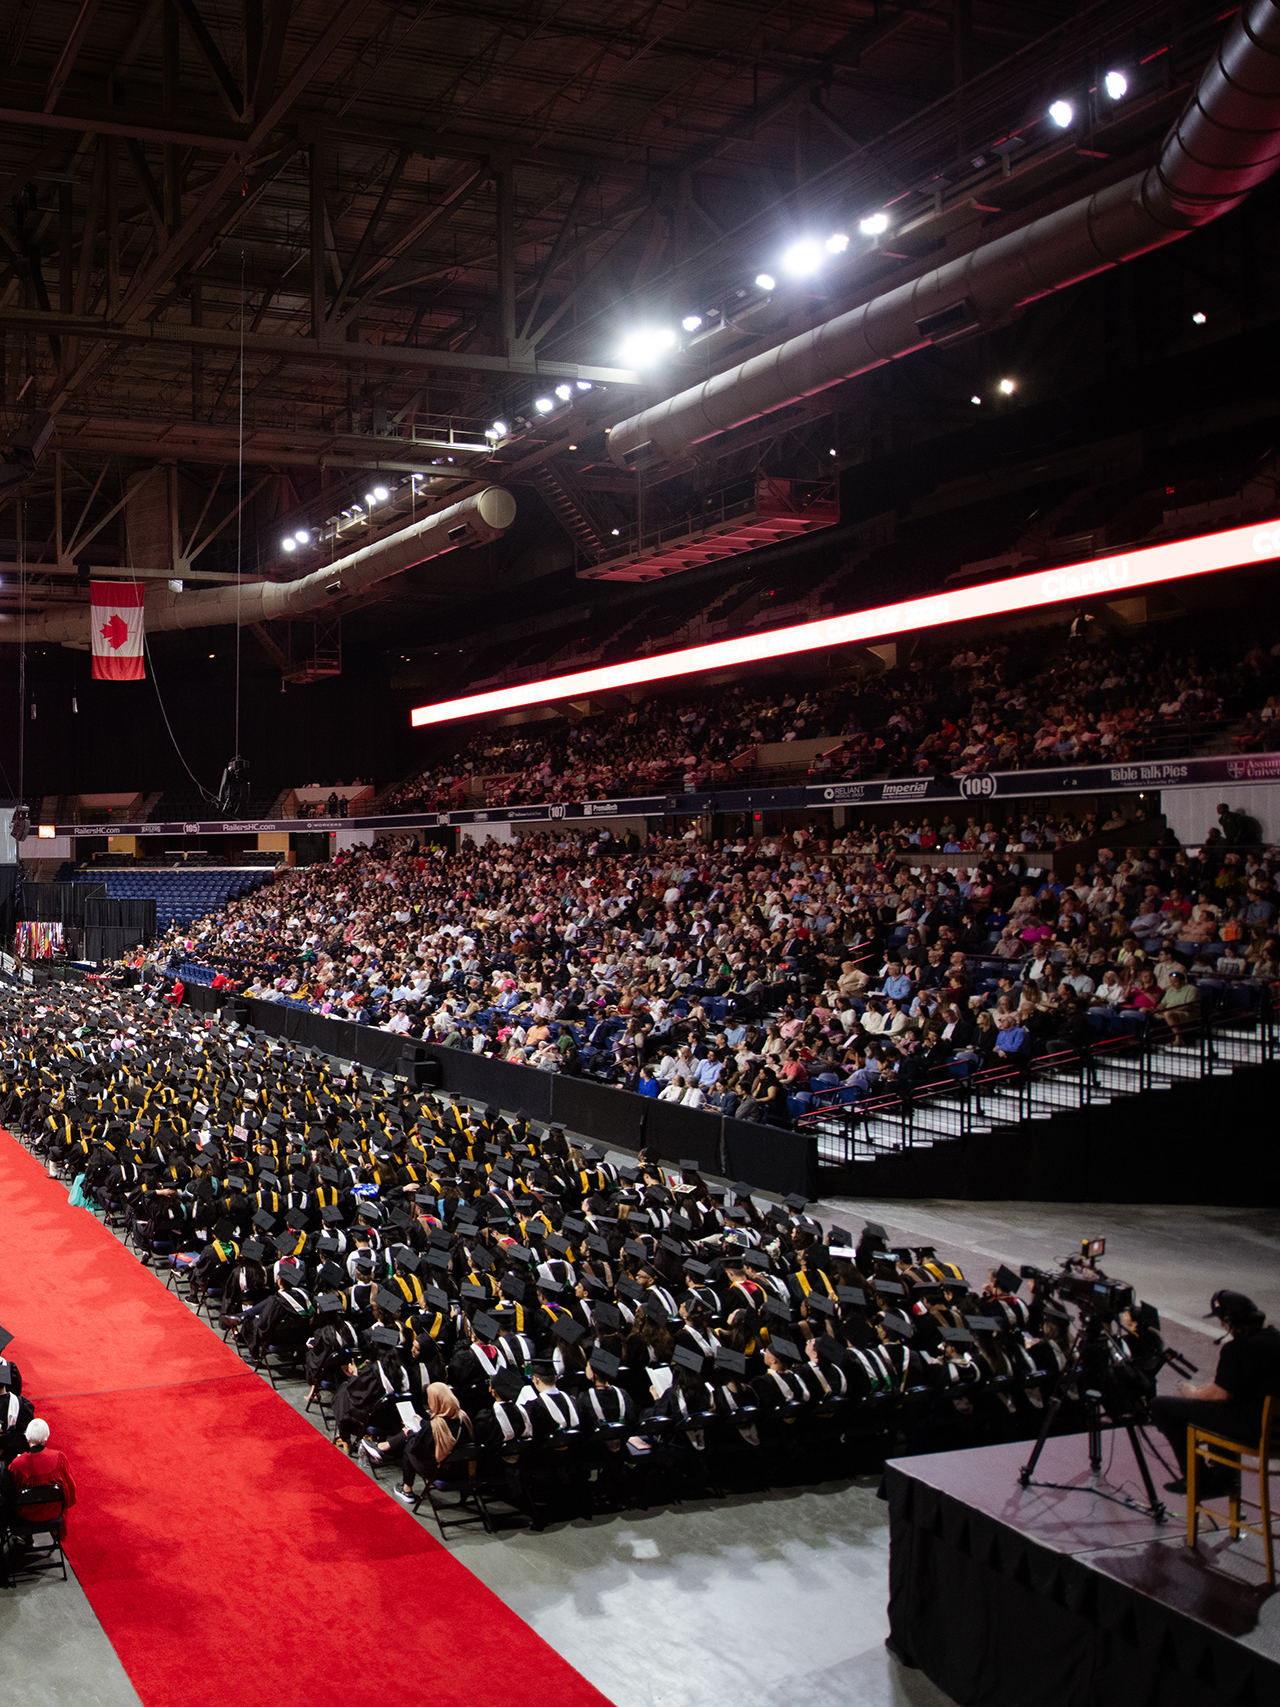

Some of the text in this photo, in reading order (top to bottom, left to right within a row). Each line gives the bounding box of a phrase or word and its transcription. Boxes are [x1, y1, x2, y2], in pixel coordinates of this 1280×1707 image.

[1041, 560, 1129, 597] ClarkU
[826, 614, 874, 640] CLASS
[876, 609, 900, 630] OF
[904, 600, 950, 625] 2024!
[1110, 765, 1188, 782] Table Talk Pies
[834, 786, 865, 795] RELIANT
[882, 781, 929, 796] Imperial
[964, 777, 993, 795] 109
[551, 806, 563, 818] 107
[74, 827, 120, 835] RailersHC.com
[185, 823, 198, 833] 105
[222, 824, 276, 832] RailersHC.com
